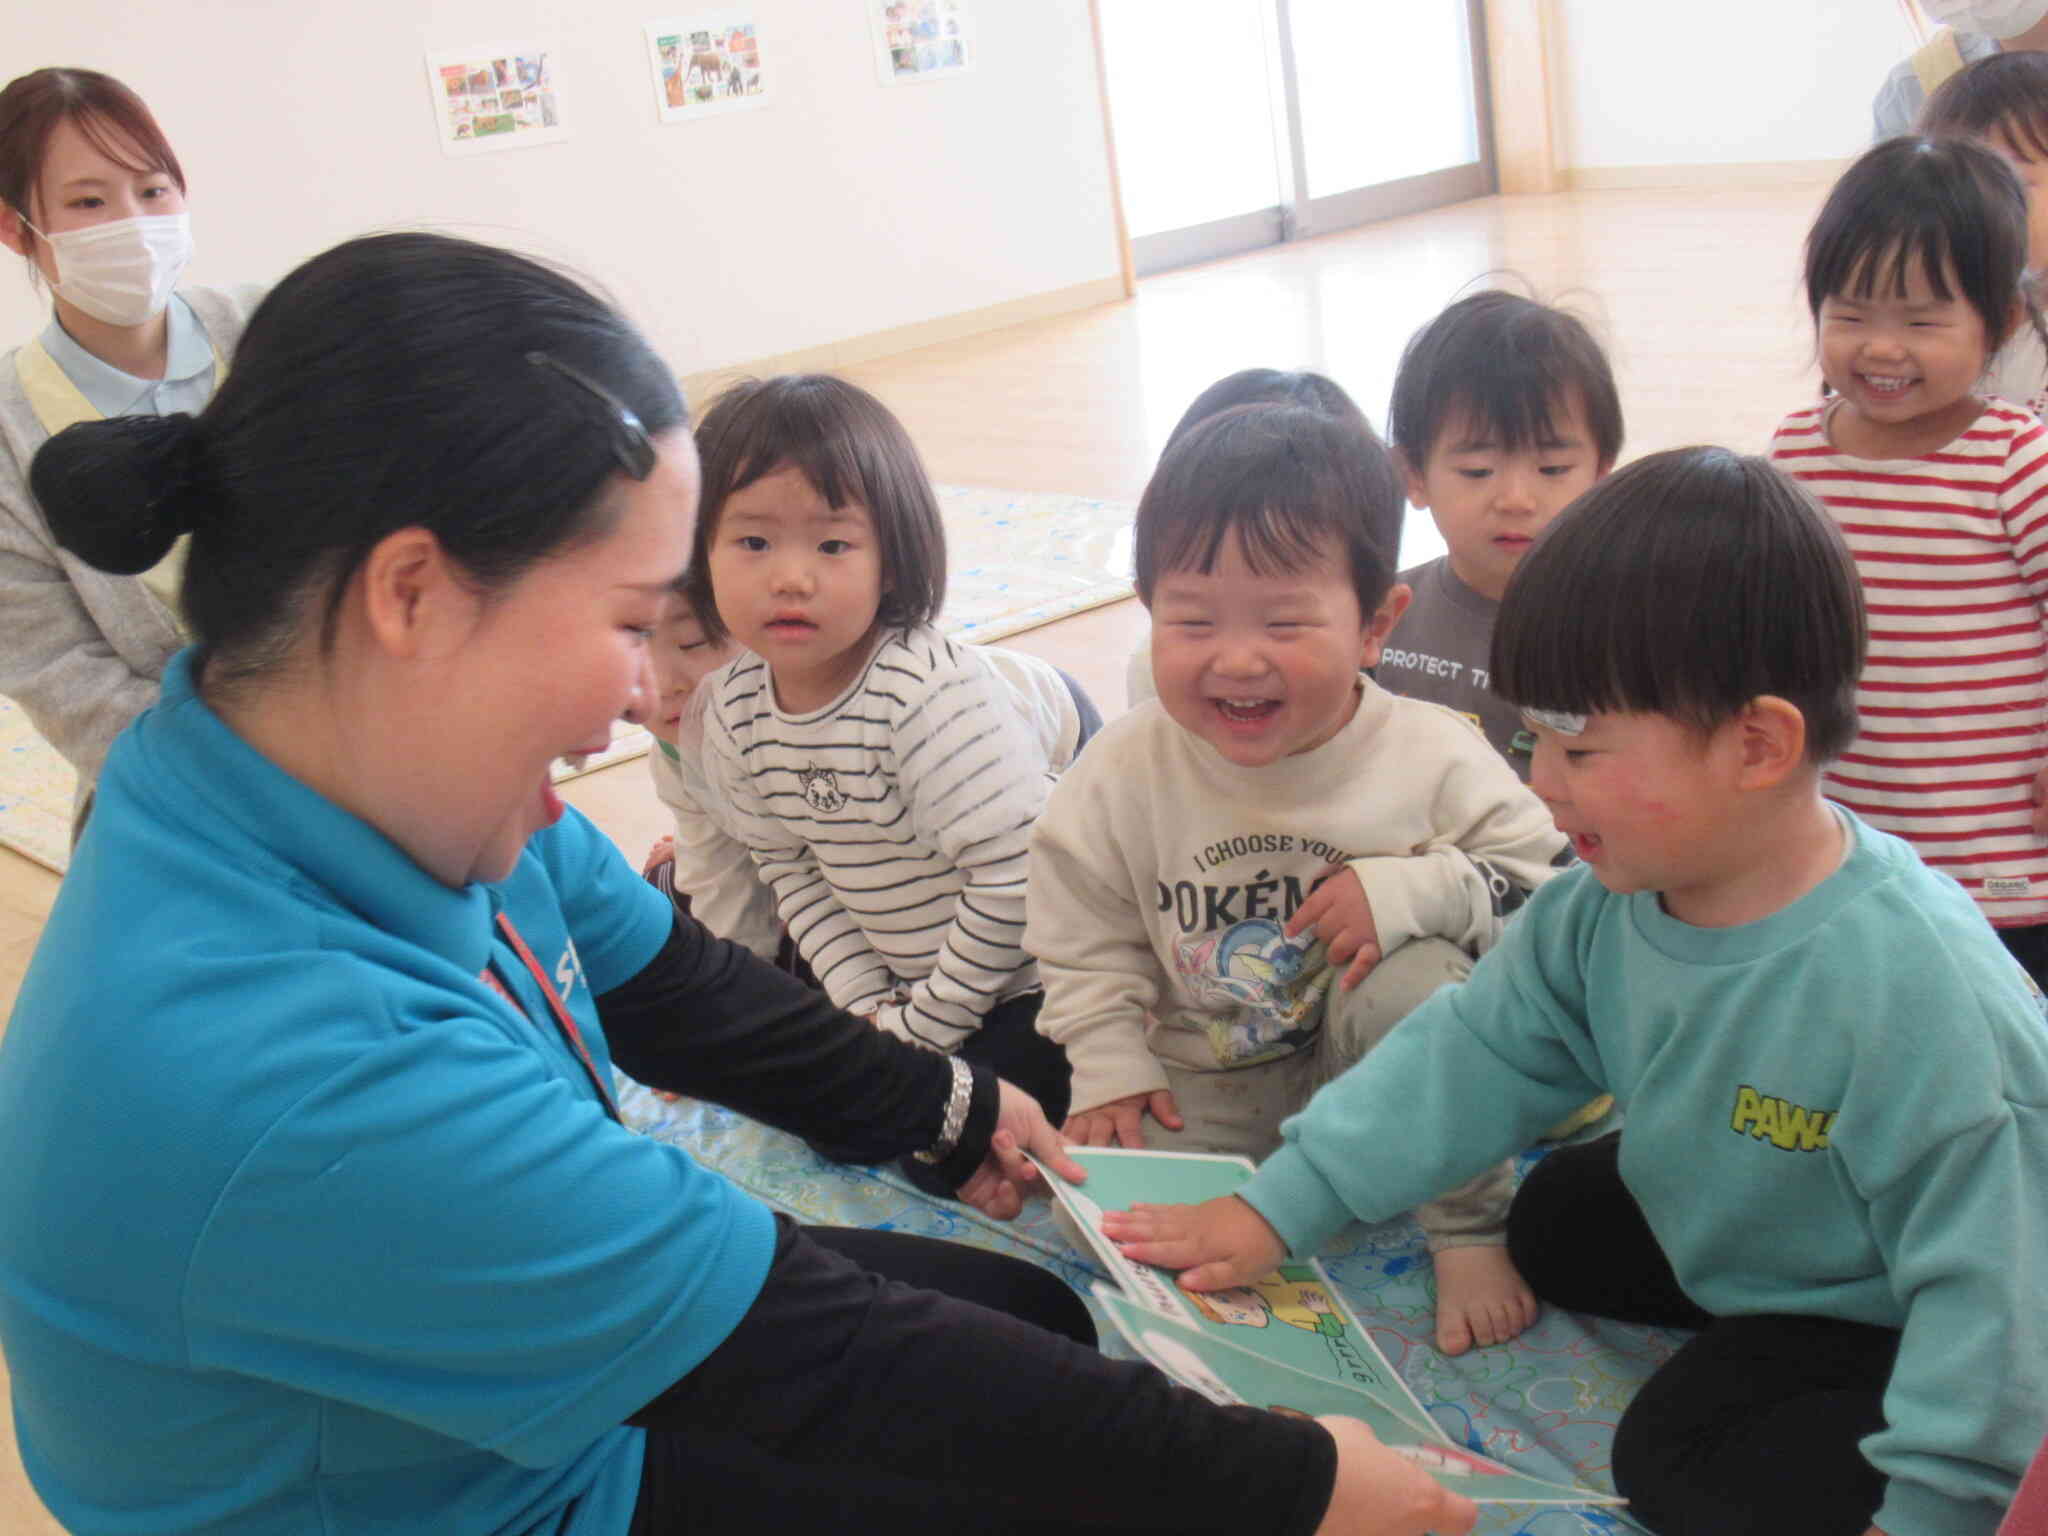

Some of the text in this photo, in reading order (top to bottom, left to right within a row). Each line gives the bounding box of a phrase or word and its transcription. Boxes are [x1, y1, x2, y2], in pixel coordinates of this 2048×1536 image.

[1381, 647, 1464, 681] PROTECT
[1193, 854, 1207, 873] I
[1204, 834, 1294, 867] CHOOSE
